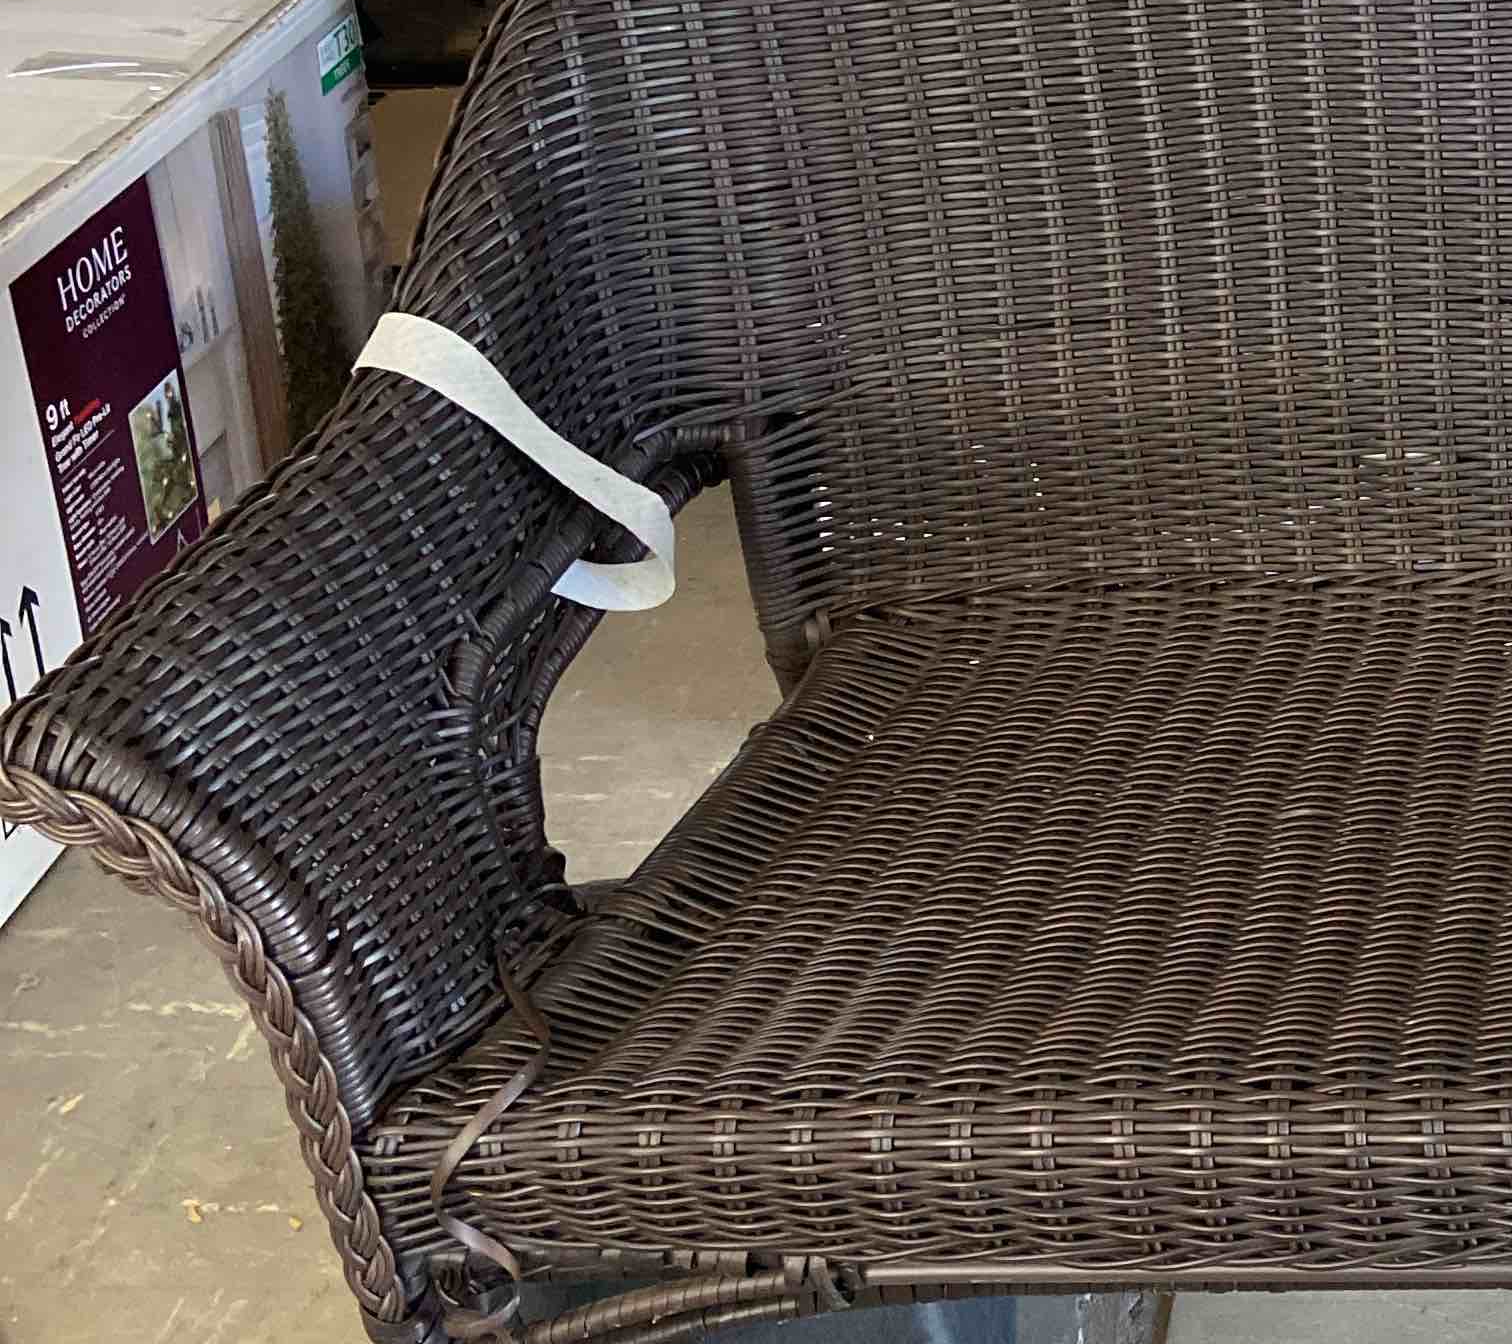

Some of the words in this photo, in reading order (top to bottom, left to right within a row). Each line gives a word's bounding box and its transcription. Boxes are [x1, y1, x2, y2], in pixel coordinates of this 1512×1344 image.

[57, 226, 128, 311] HOME
[65, 264, 132, 333] DECORATORS
[82, 294, 126, 339] COLLECTION
[45, 404, 59, 431] 9
